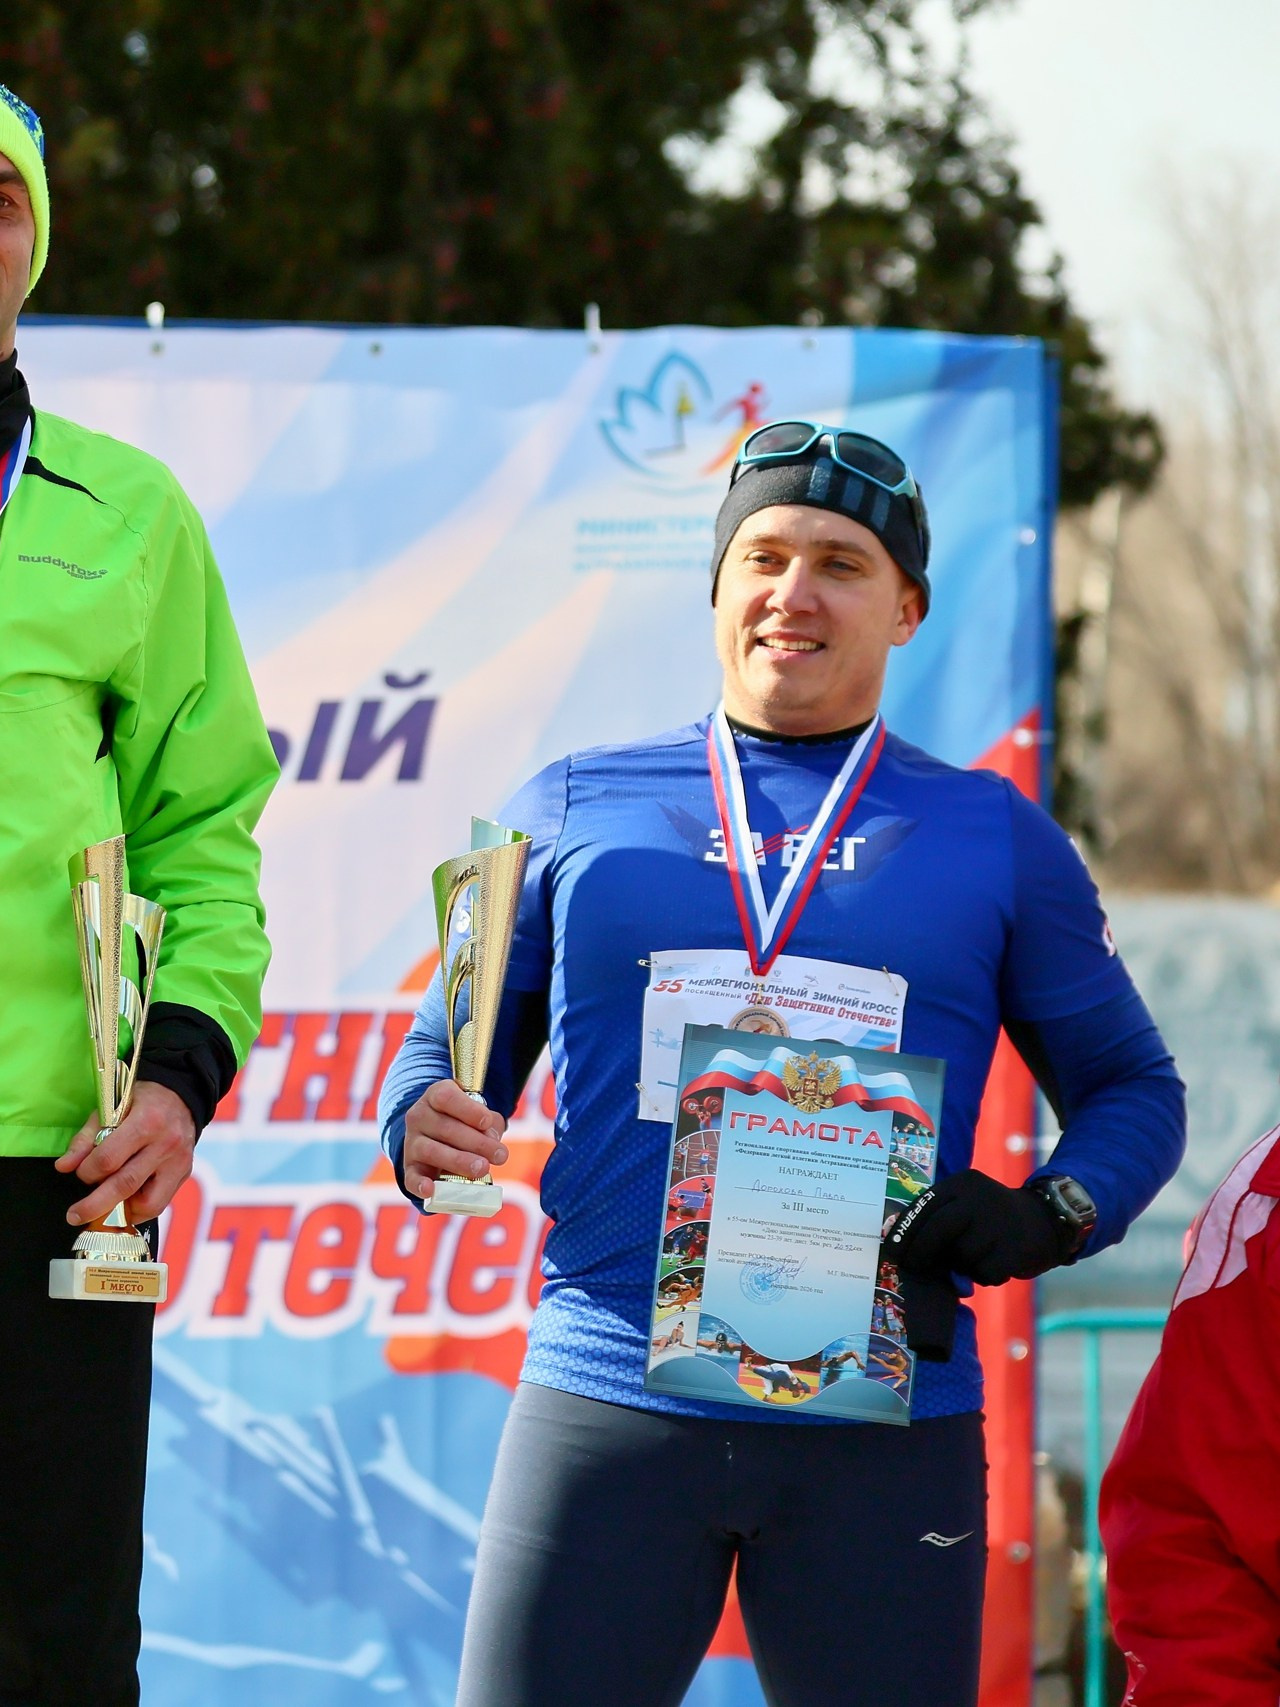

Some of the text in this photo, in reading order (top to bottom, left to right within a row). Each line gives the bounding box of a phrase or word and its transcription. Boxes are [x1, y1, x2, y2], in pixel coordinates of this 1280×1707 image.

[652, 978, 899, 1016] 55 МЕЖРЕГИОНАЛЬНЫЙ ЗИМНИЙ КРОСС
[774, 995, 835, 1016] Защитника
[838, 1008, 897, 1028] Отечества»
[729, 1111, 885, 1149] ГРАМОТА
[820, 1158, 860, 1169] Астраханской
[778, 1166, 839, 1181] НАГРАЖДАЕТ
[781, 1202, 830, 1216] За III место
[100, 1281, 144, 1292] I МЕСТО
